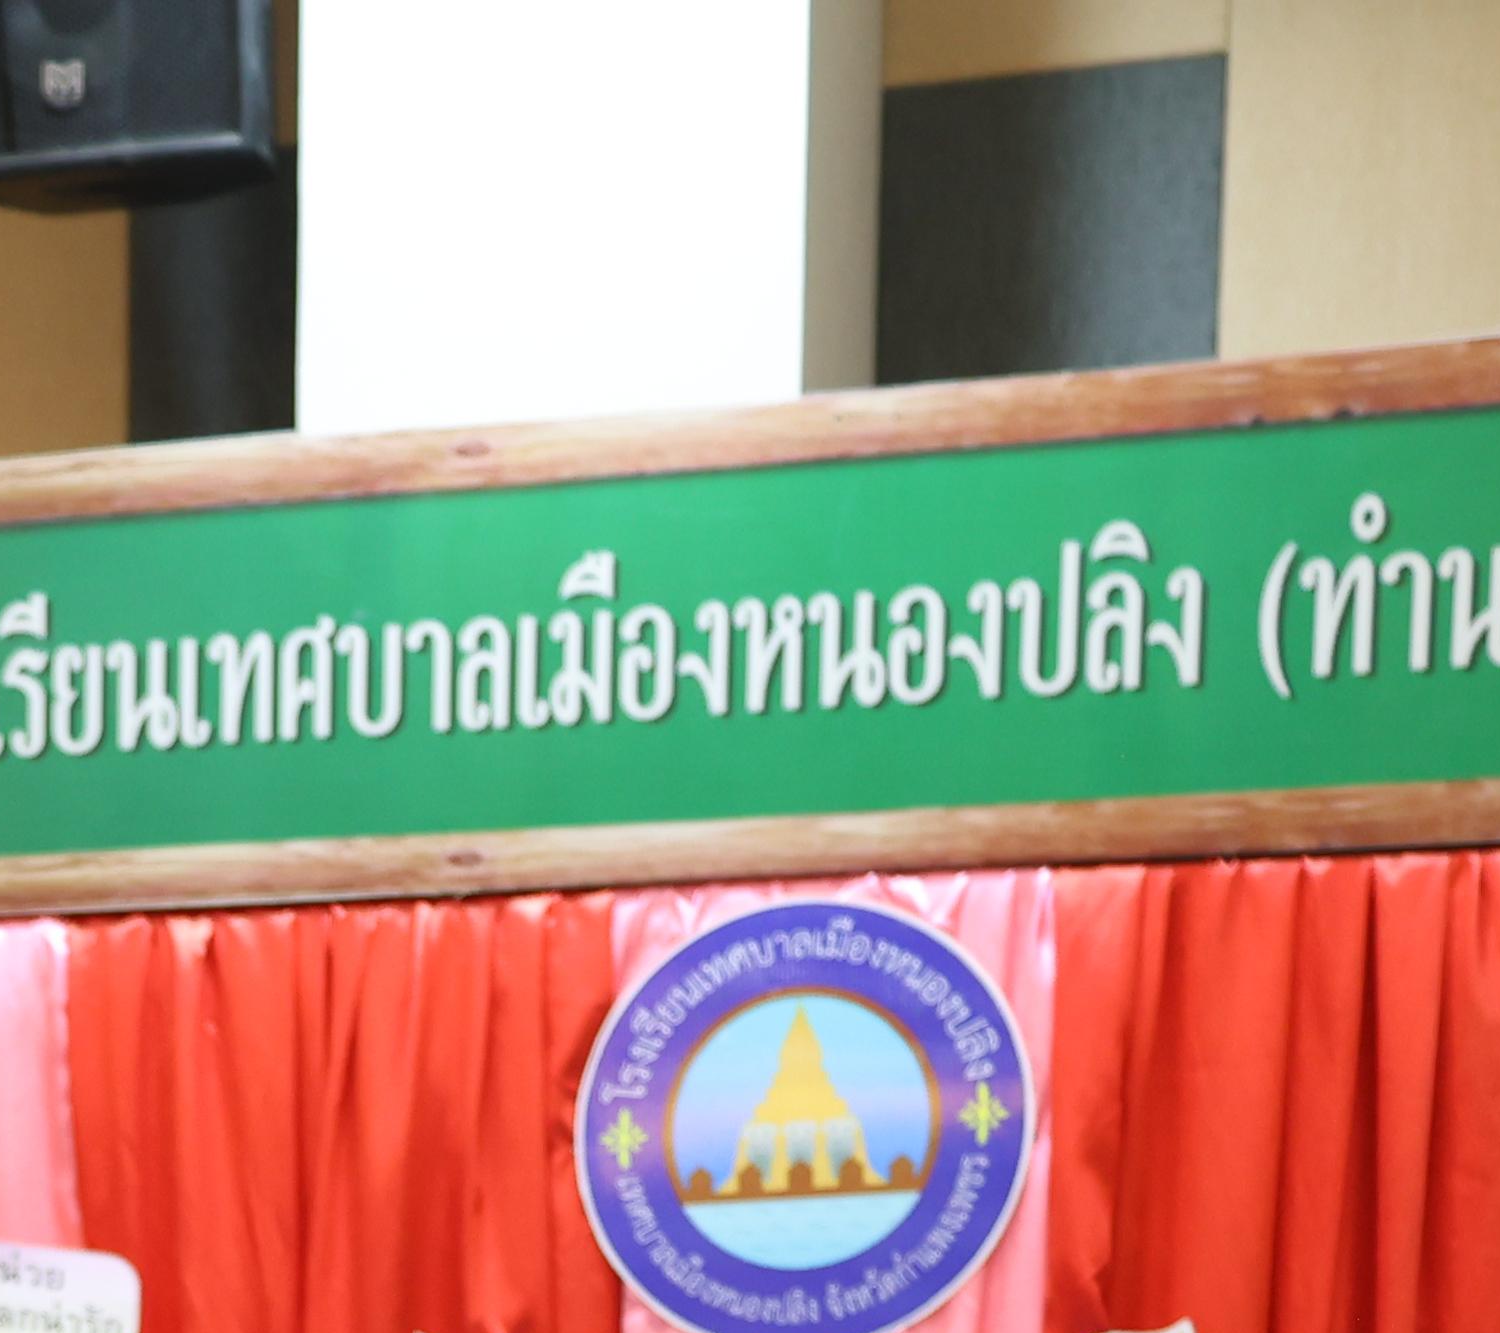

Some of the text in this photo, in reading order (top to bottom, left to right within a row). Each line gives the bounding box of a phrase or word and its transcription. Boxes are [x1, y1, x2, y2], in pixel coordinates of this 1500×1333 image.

[601, 915, 1001, 1104] โรงเรียนเทศบาลเมืองหนองปลิง
